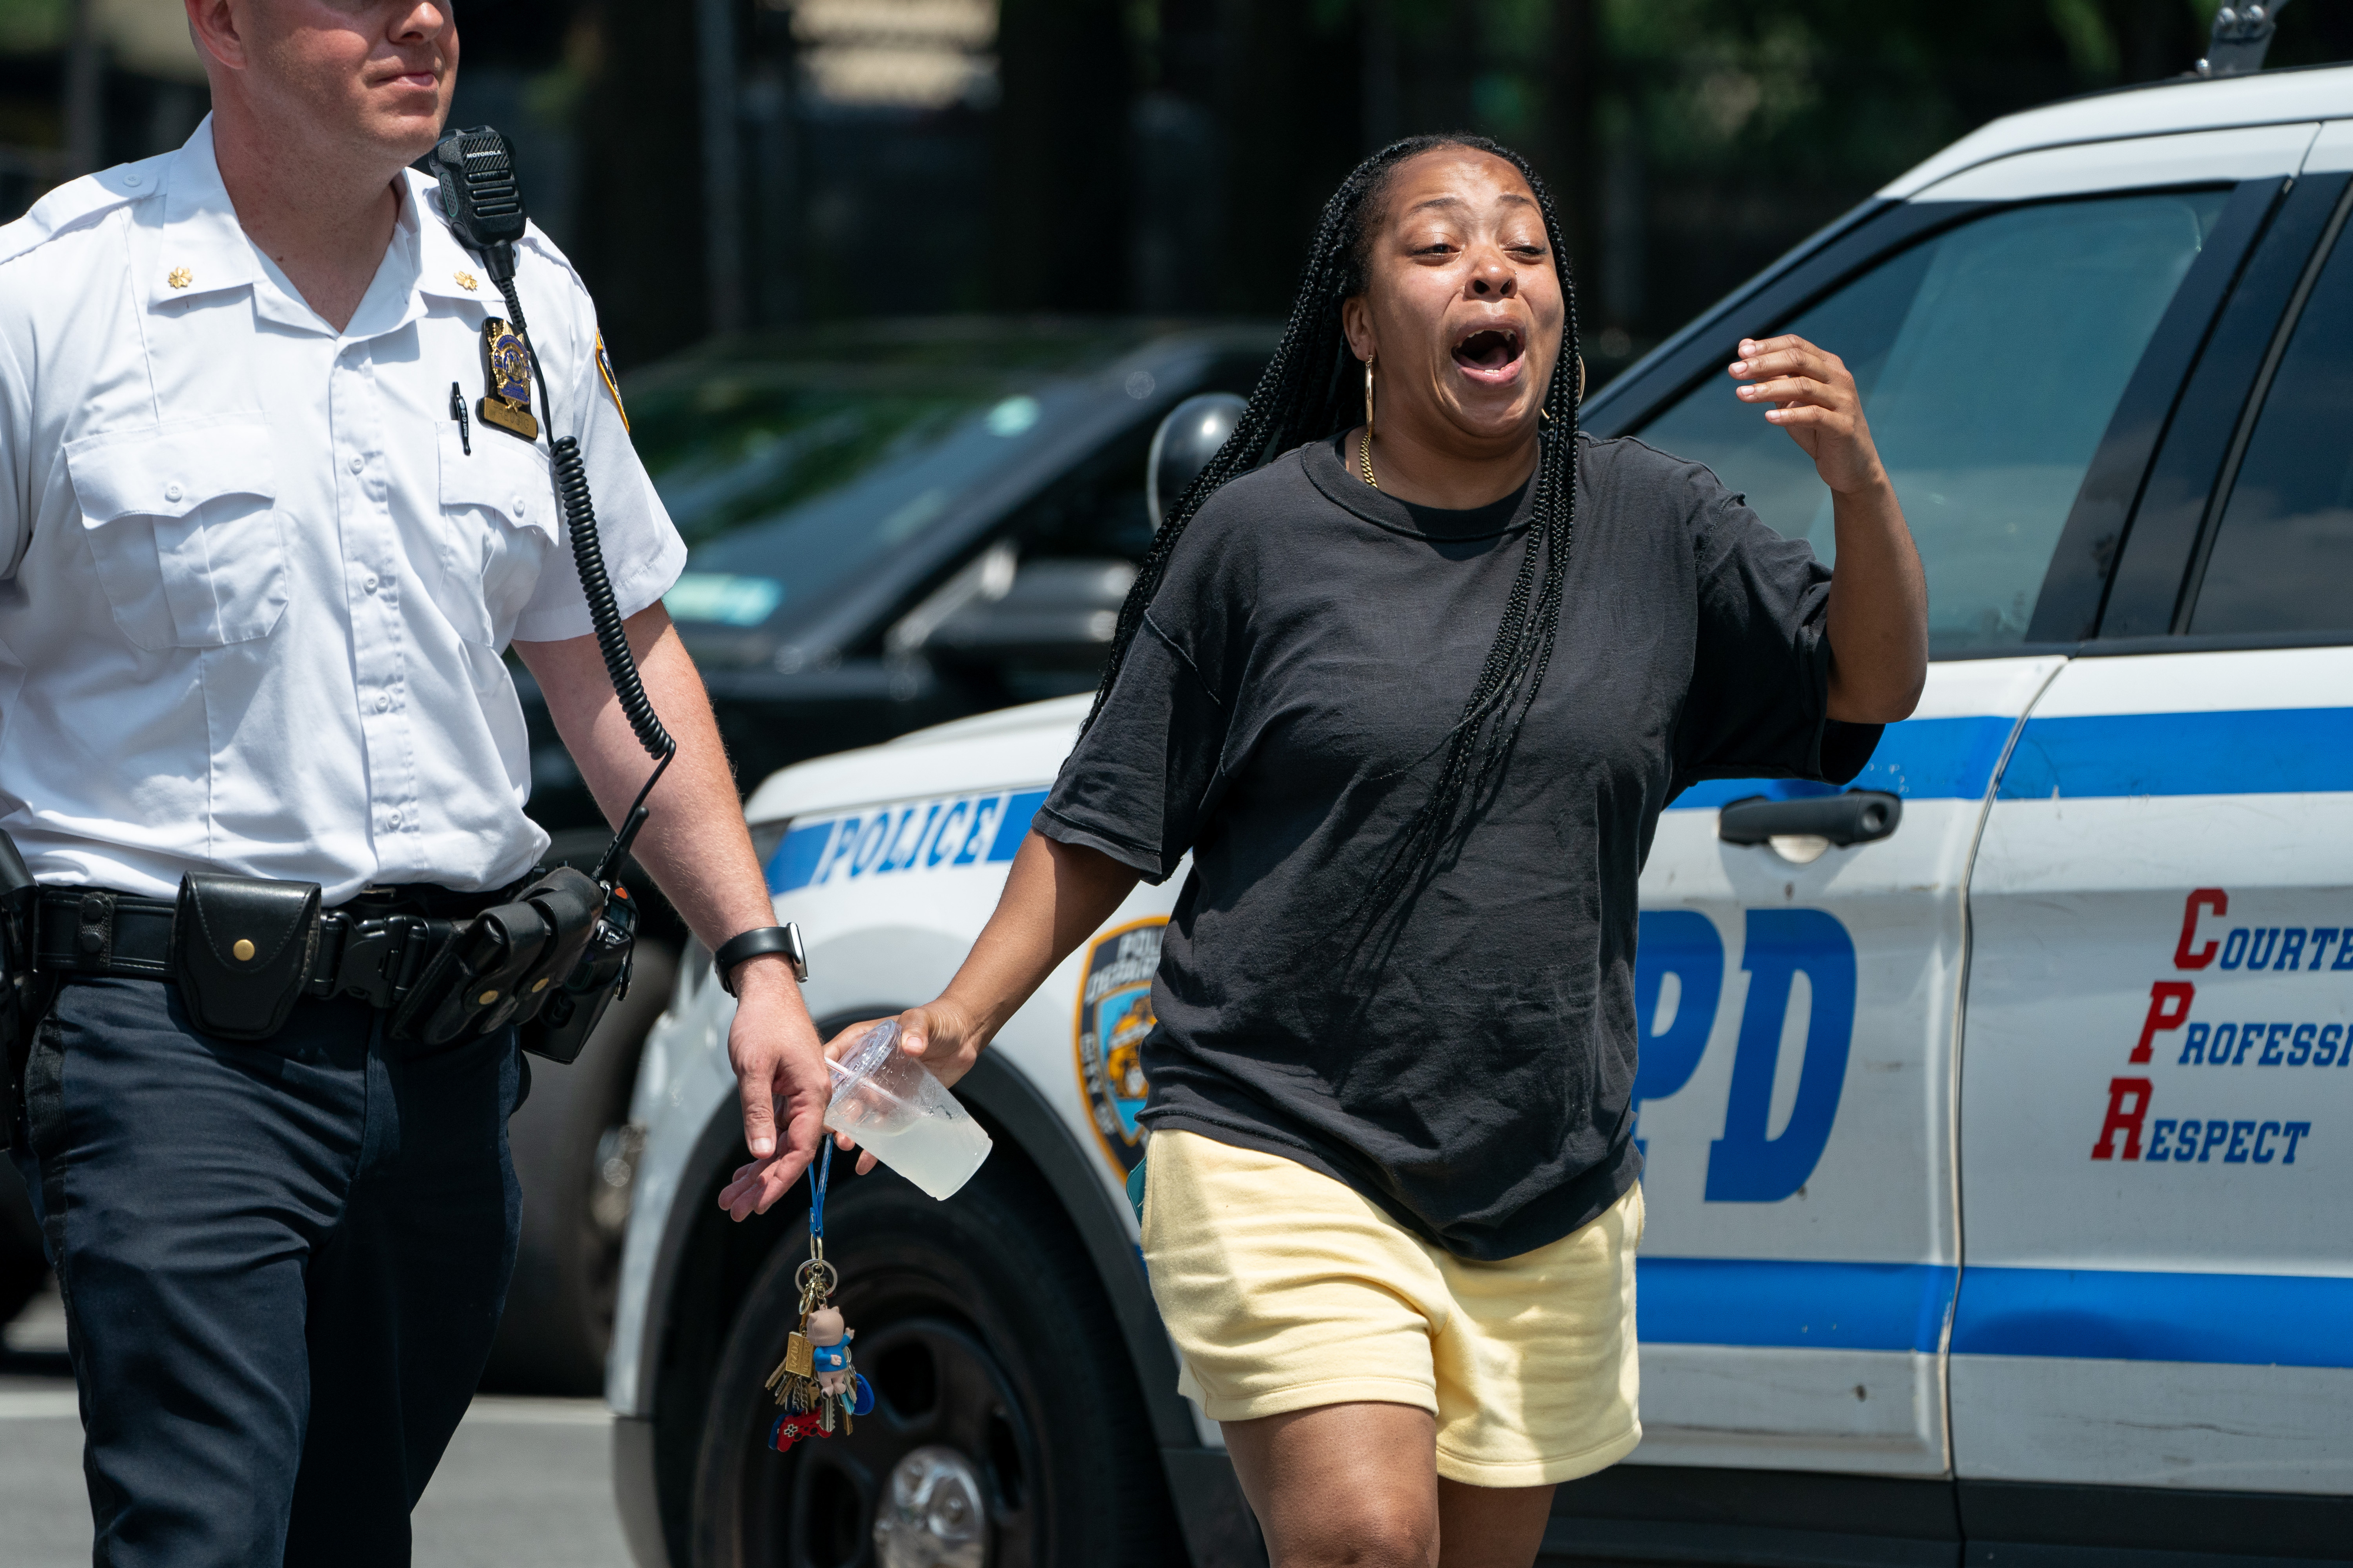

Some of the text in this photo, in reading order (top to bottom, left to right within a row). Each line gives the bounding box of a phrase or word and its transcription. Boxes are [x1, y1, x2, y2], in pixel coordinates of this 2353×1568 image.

[466, 149, 501, 158] MOTOROLA
[821, 796, 1001, 886] POLICE
[2091, 1077, 2311, 1163] RESPECT
